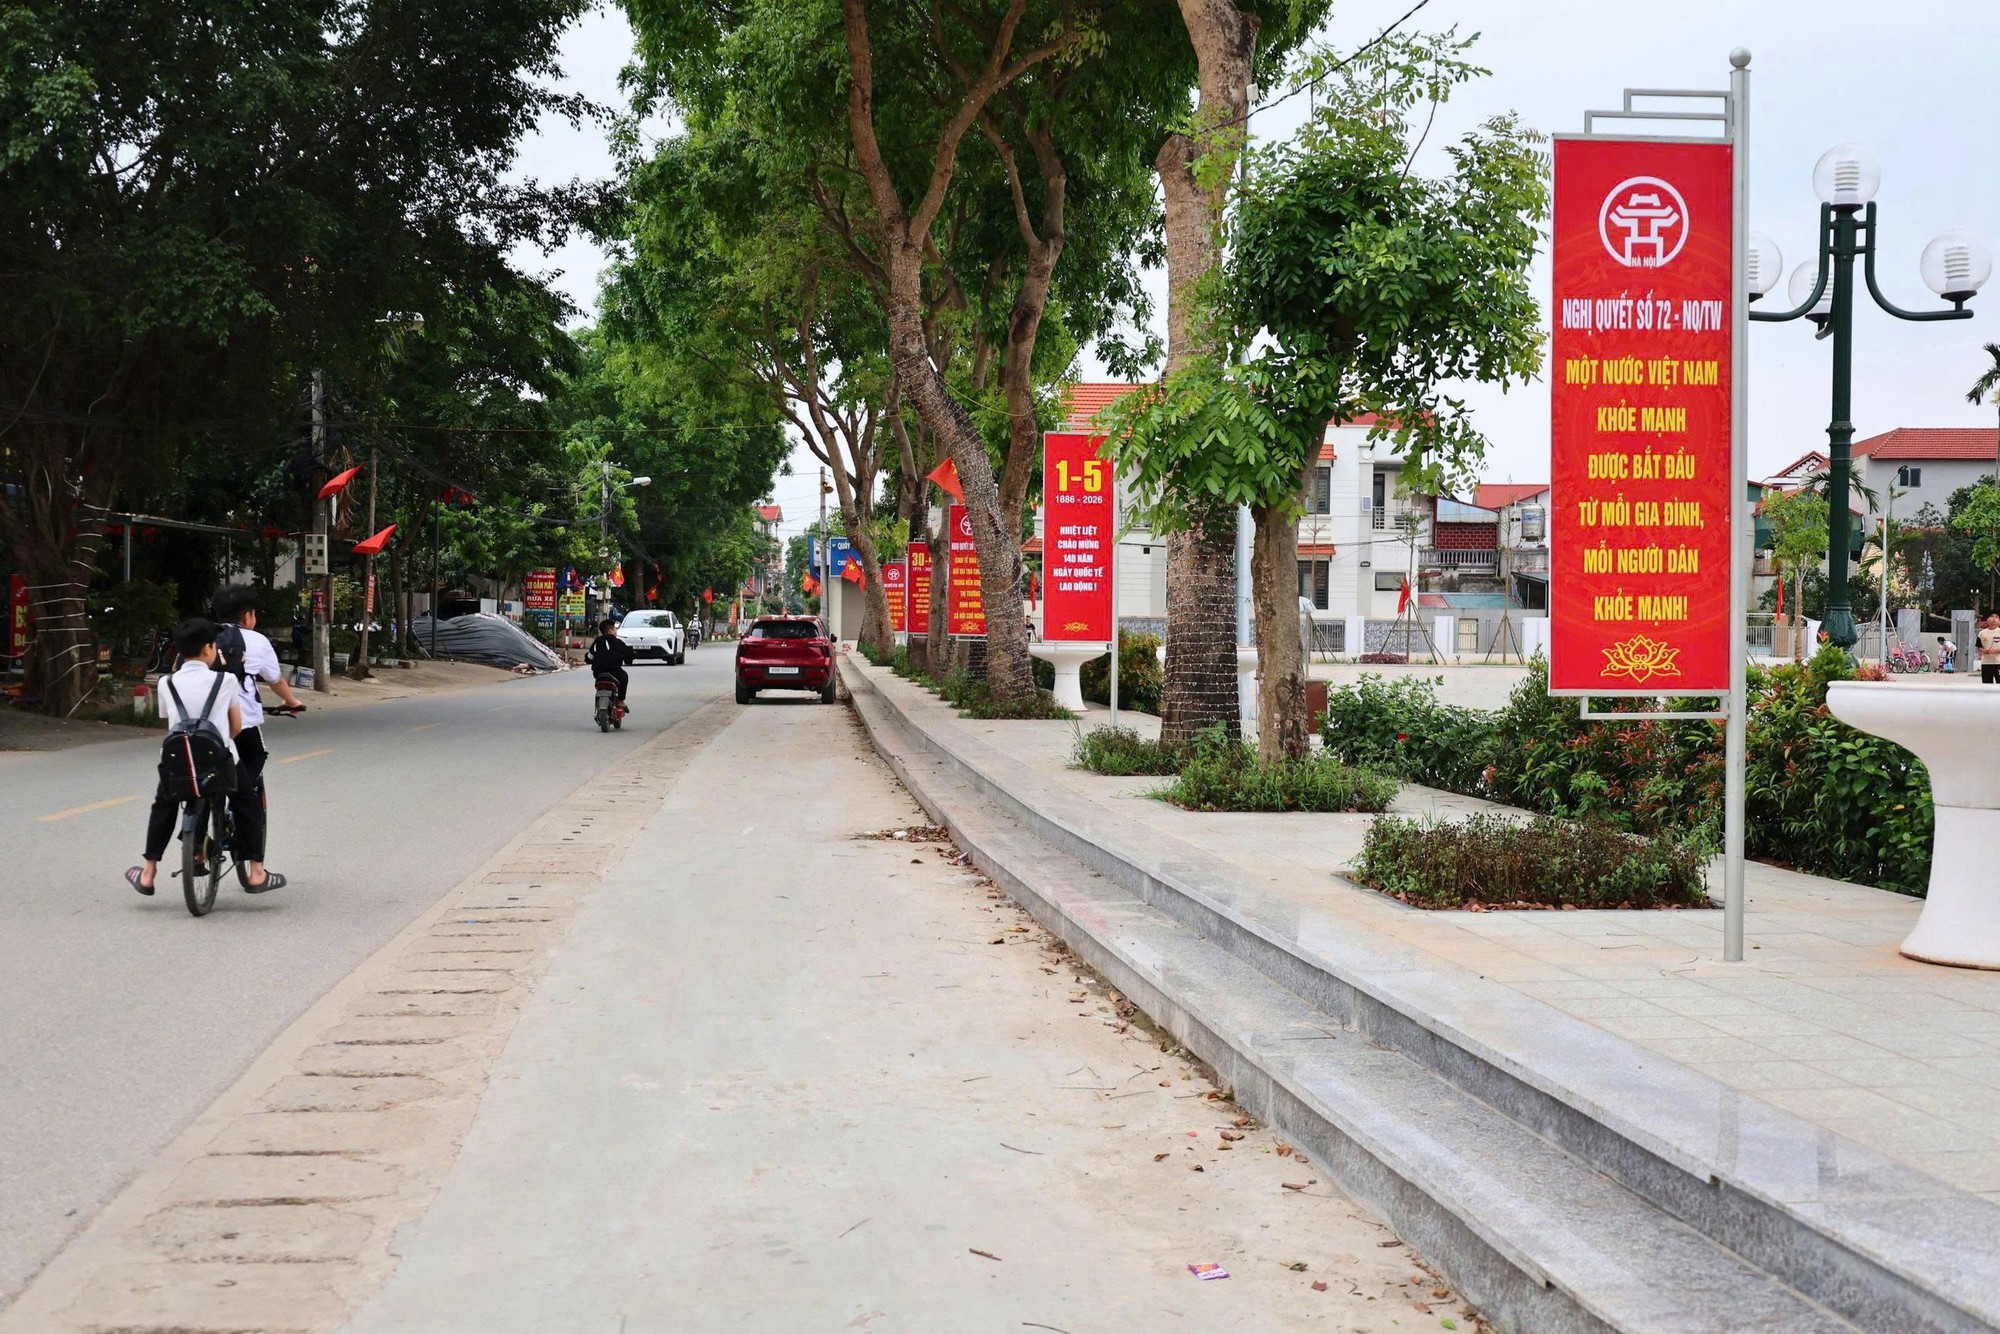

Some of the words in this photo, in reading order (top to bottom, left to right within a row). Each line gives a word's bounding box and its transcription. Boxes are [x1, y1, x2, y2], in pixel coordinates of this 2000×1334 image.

[1631, 257, 1641, 267] HÀ
[1643, 257, 1657, 268] NỘI
[1562, 299, 1592, 335] NGHỊ
[1595, 289, 1634, 330] QUYẾT
[1636, 288, 1653, 330] SỐ
[1656, 302, 1671, 330] 72
[1682, 300, 1723, 333] NQ/TW
[1566, 354, 1598, 390] MỘT
[1602, 355, 1643, 385] NƯỚC
[1648, 356, 1679, 391] VIỆT
[1683, 361, 1718, 385] NAM
[1597, 399, 1636, 432] KHỎE
[1641, 407, 1686, 437] MẠNH
[1056, 460, 1102, 492] 1-5
[1587, 454, 1628, 484] ĐƯỢC
[1633, 445, 1661, 479] BẮT
[1664, 446, 1695, 479] ĐẦU
[1055, 495, 1075, 503] 1886
[1082, 495, 1103, 504] 2026
[1578, 496, 1598, 526] TỪ
[1601, 493, 1630, 526] MỖI
[1634, 502, 1660, 526] GIA
[1663, 496, 1704, 530] ĐÌNH,
[1058, 539, 1077, 549] CHÀO
[1078, 539, 1099, 549] MỪNG
[1060, 525, 1081, 536] NHIỆT
[1082, 525, 1097, 536] LIỆT
[1053, 567, 1072, 577] NGÀY
[1073, 567, 1093, 577] QUỐC
[1094, 566, 1103, 577] TẾ
[1063, 554, 1076, 563] 140
[1077, 553, 1094, 563] NĂM
[1584, 540, 1613, 574] MỖI
[1617, 543, 1663, 574] NGƯỜI
[1668, 544, 1699, 574] DÂN
[1059, 582, 1072, 591] LAO
[1073, 581, 1093, 593] ĐỘNG
[1594, 588, 1633, 621] KHỎE
[1638, 596, 1688, 627] MẠNH!
